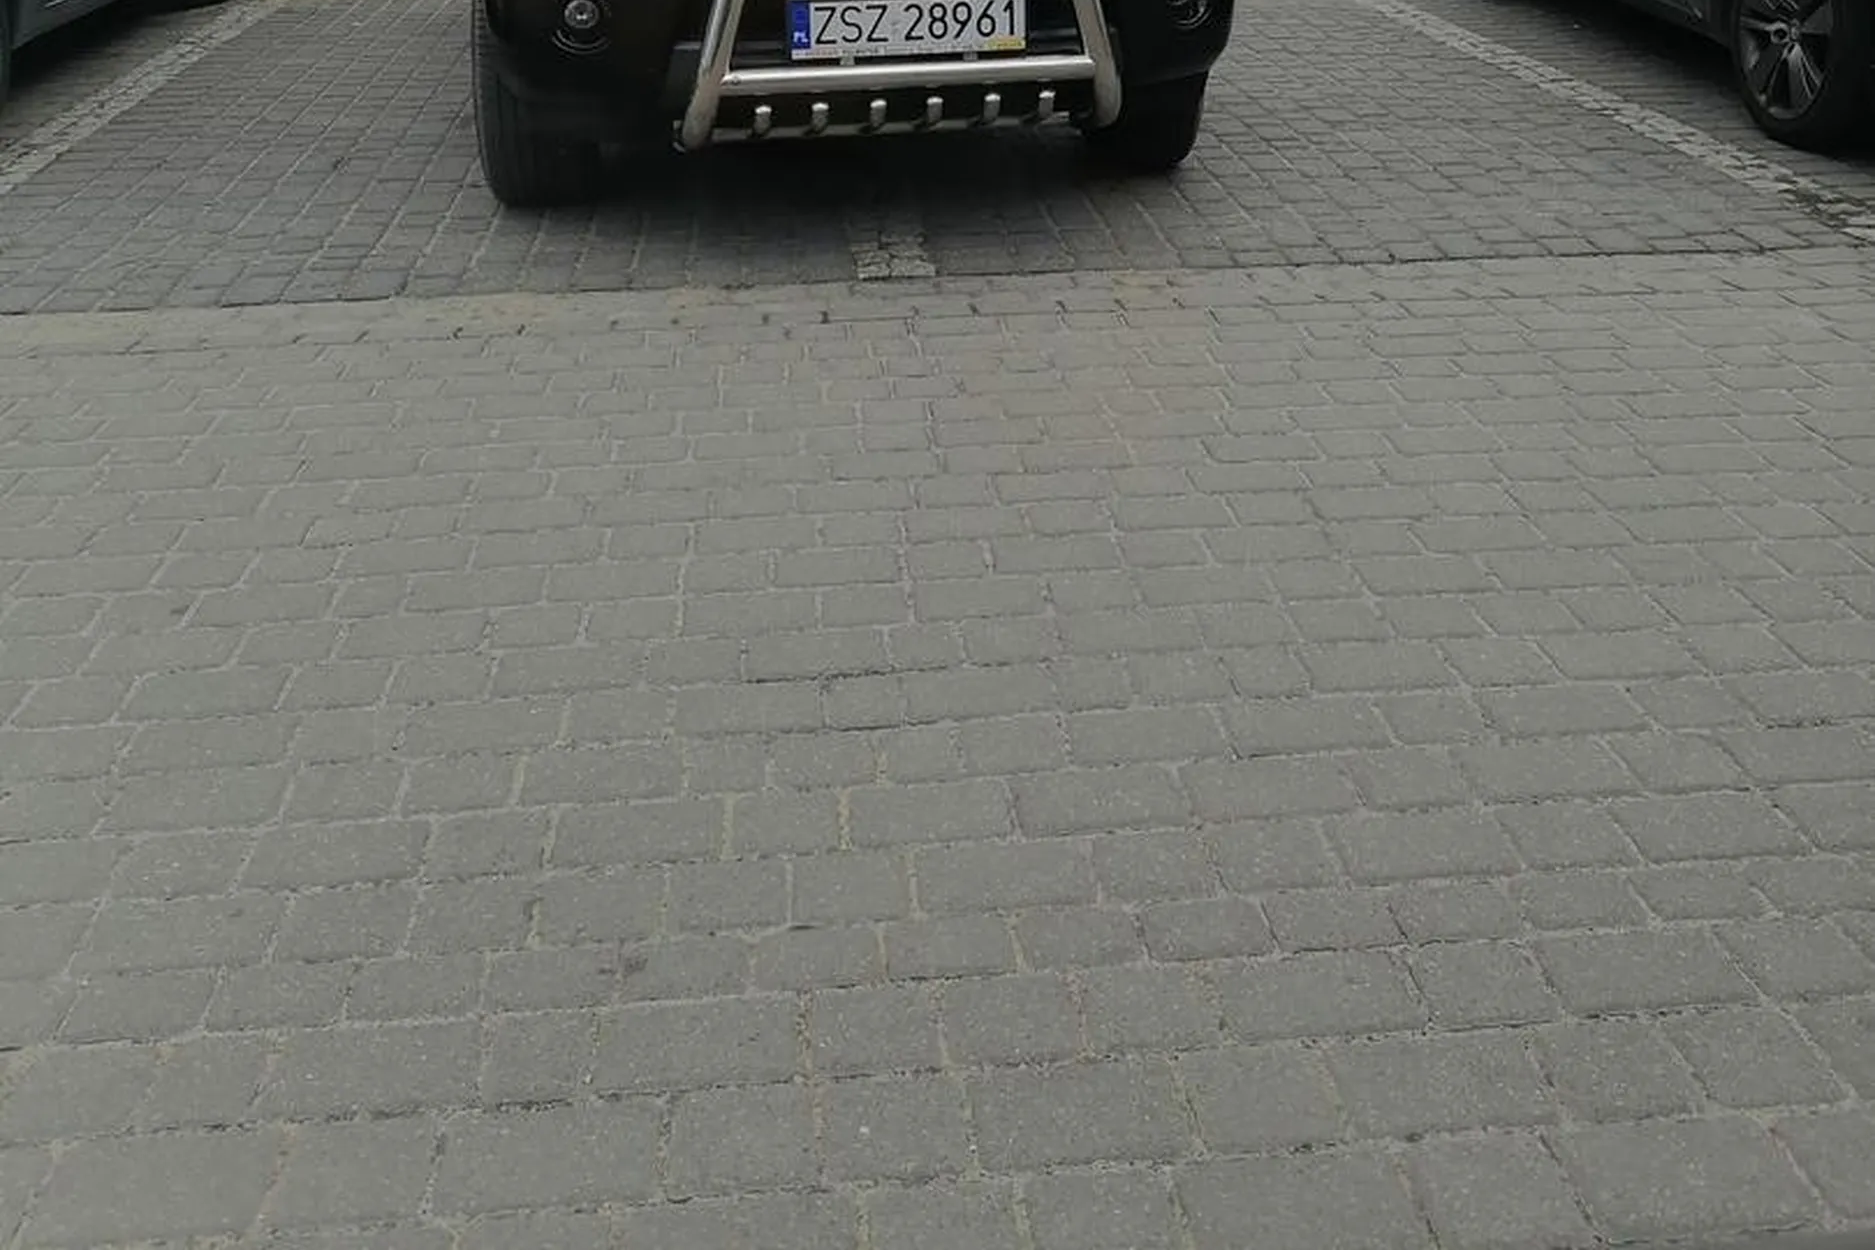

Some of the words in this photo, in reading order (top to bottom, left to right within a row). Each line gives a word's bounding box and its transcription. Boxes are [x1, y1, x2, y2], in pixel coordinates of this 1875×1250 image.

[793, 31, 808, 43] PL
[814, 4, 888, 45] ZSZ
[903, 0, 1015, 41] 28961
